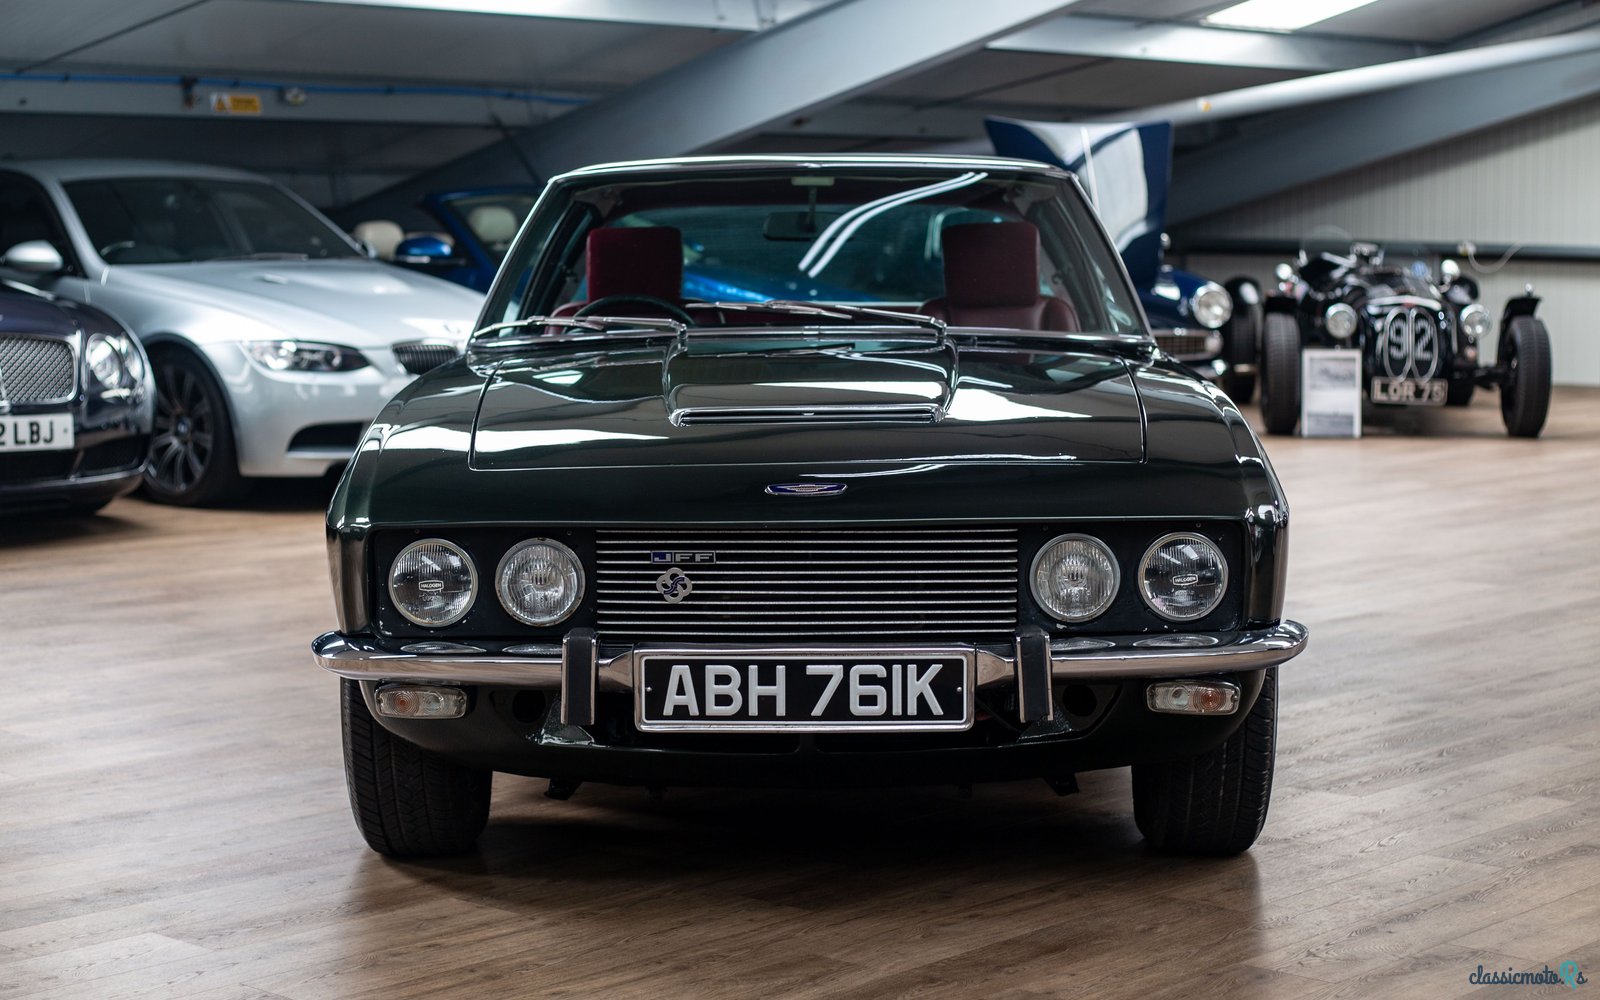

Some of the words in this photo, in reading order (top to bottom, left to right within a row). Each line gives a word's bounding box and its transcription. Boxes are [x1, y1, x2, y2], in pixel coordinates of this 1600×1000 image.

[1389, 319, 1434, 359] 92
[14, 420, 53, 445] LBJ
[663, 664, 786, 716] ABH
[806, 664, 943, 716] 761K
